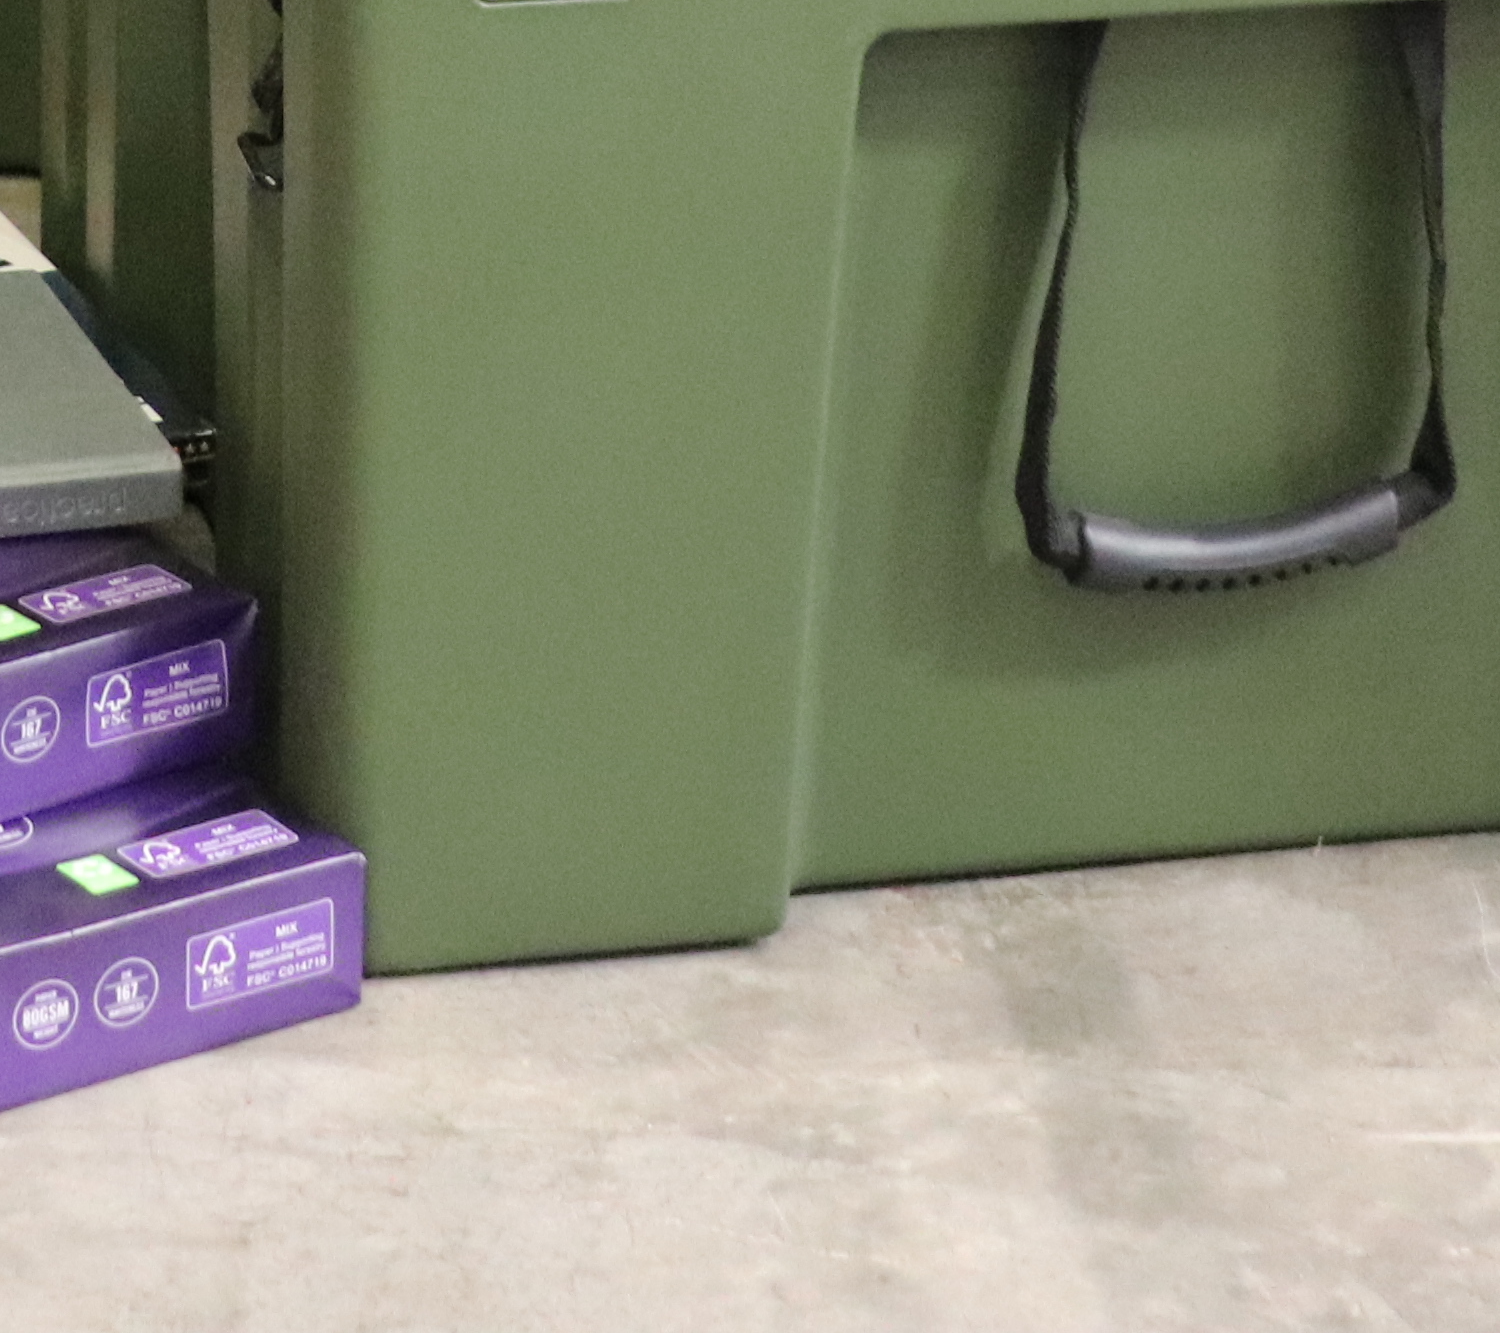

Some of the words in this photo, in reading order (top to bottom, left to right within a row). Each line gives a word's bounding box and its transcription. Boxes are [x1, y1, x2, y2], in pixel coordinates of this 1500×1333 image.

[168, 660, 191, 676] MIX
[21, 717, 42, 739] 167
[100, 711, 132, 730] FSC
[275, 920, 299, 937] MIX
[279, 955, 329, 980] C014719
[115, 980, 140, 1004] 167
[22, 999, 70, 1032] 80GSM
